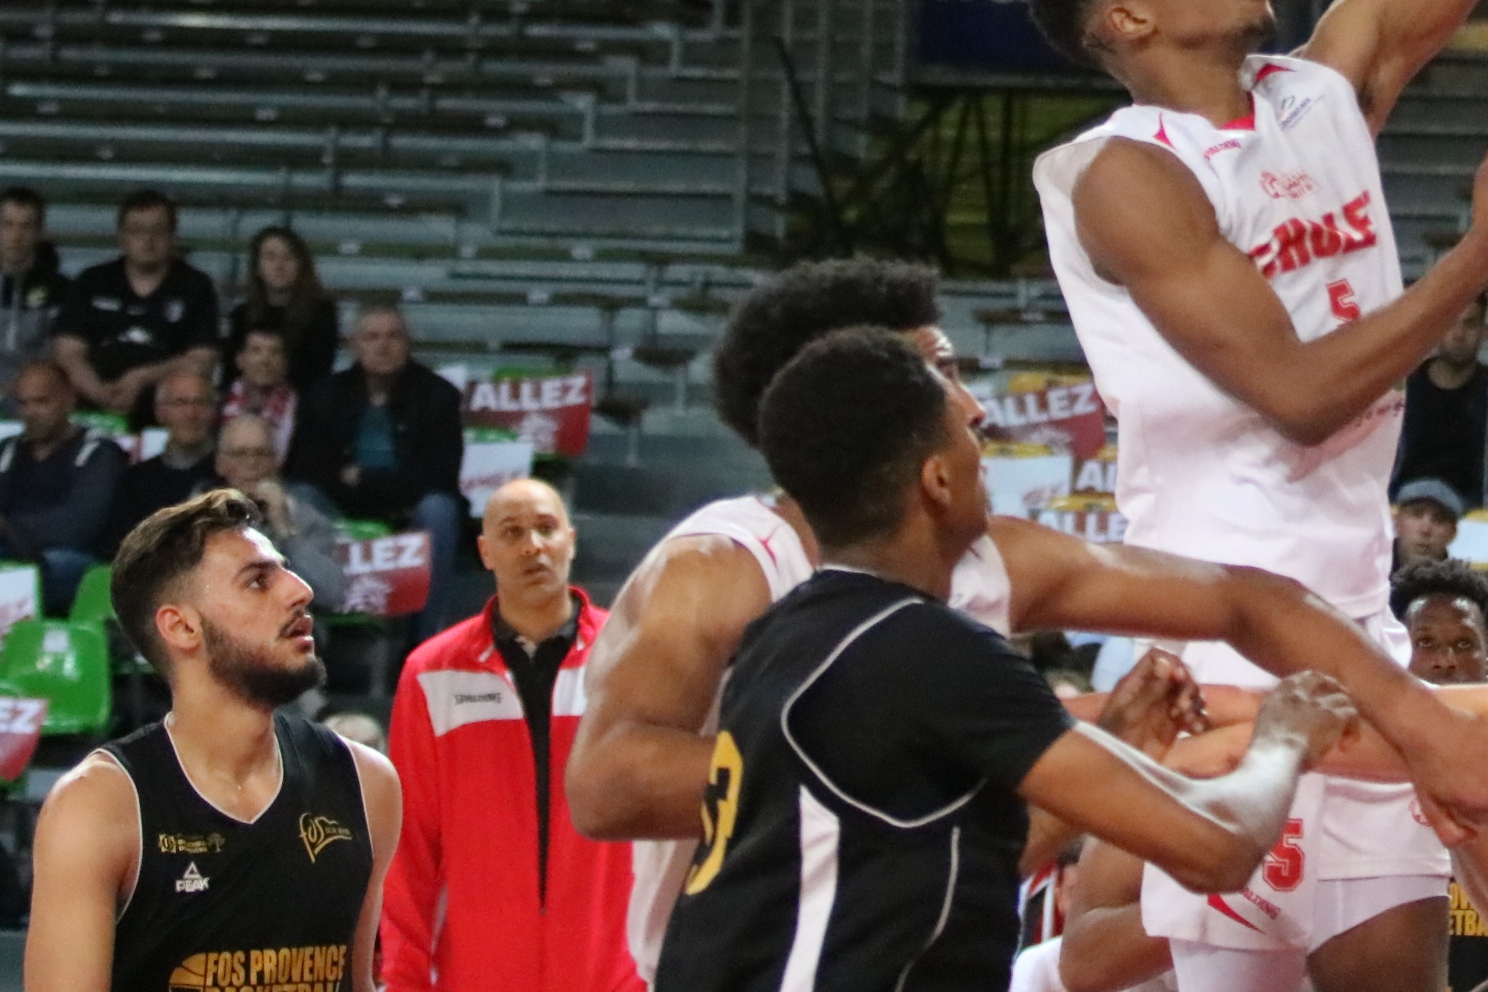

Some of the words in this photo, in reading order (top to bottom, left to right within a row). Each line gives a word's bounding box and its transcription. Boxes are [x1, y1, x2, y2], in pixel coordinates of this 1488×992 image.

[470, 375, 587, 412] ALLEZ
[980, 382, 1098, 428] ALLEZ
[1263, 818, 1305, 892] 5
[175, 876, 210, 893] PEAK
[206, 949, 246, 987] FOS
[250, 945, 347, 986] PROVENCE
